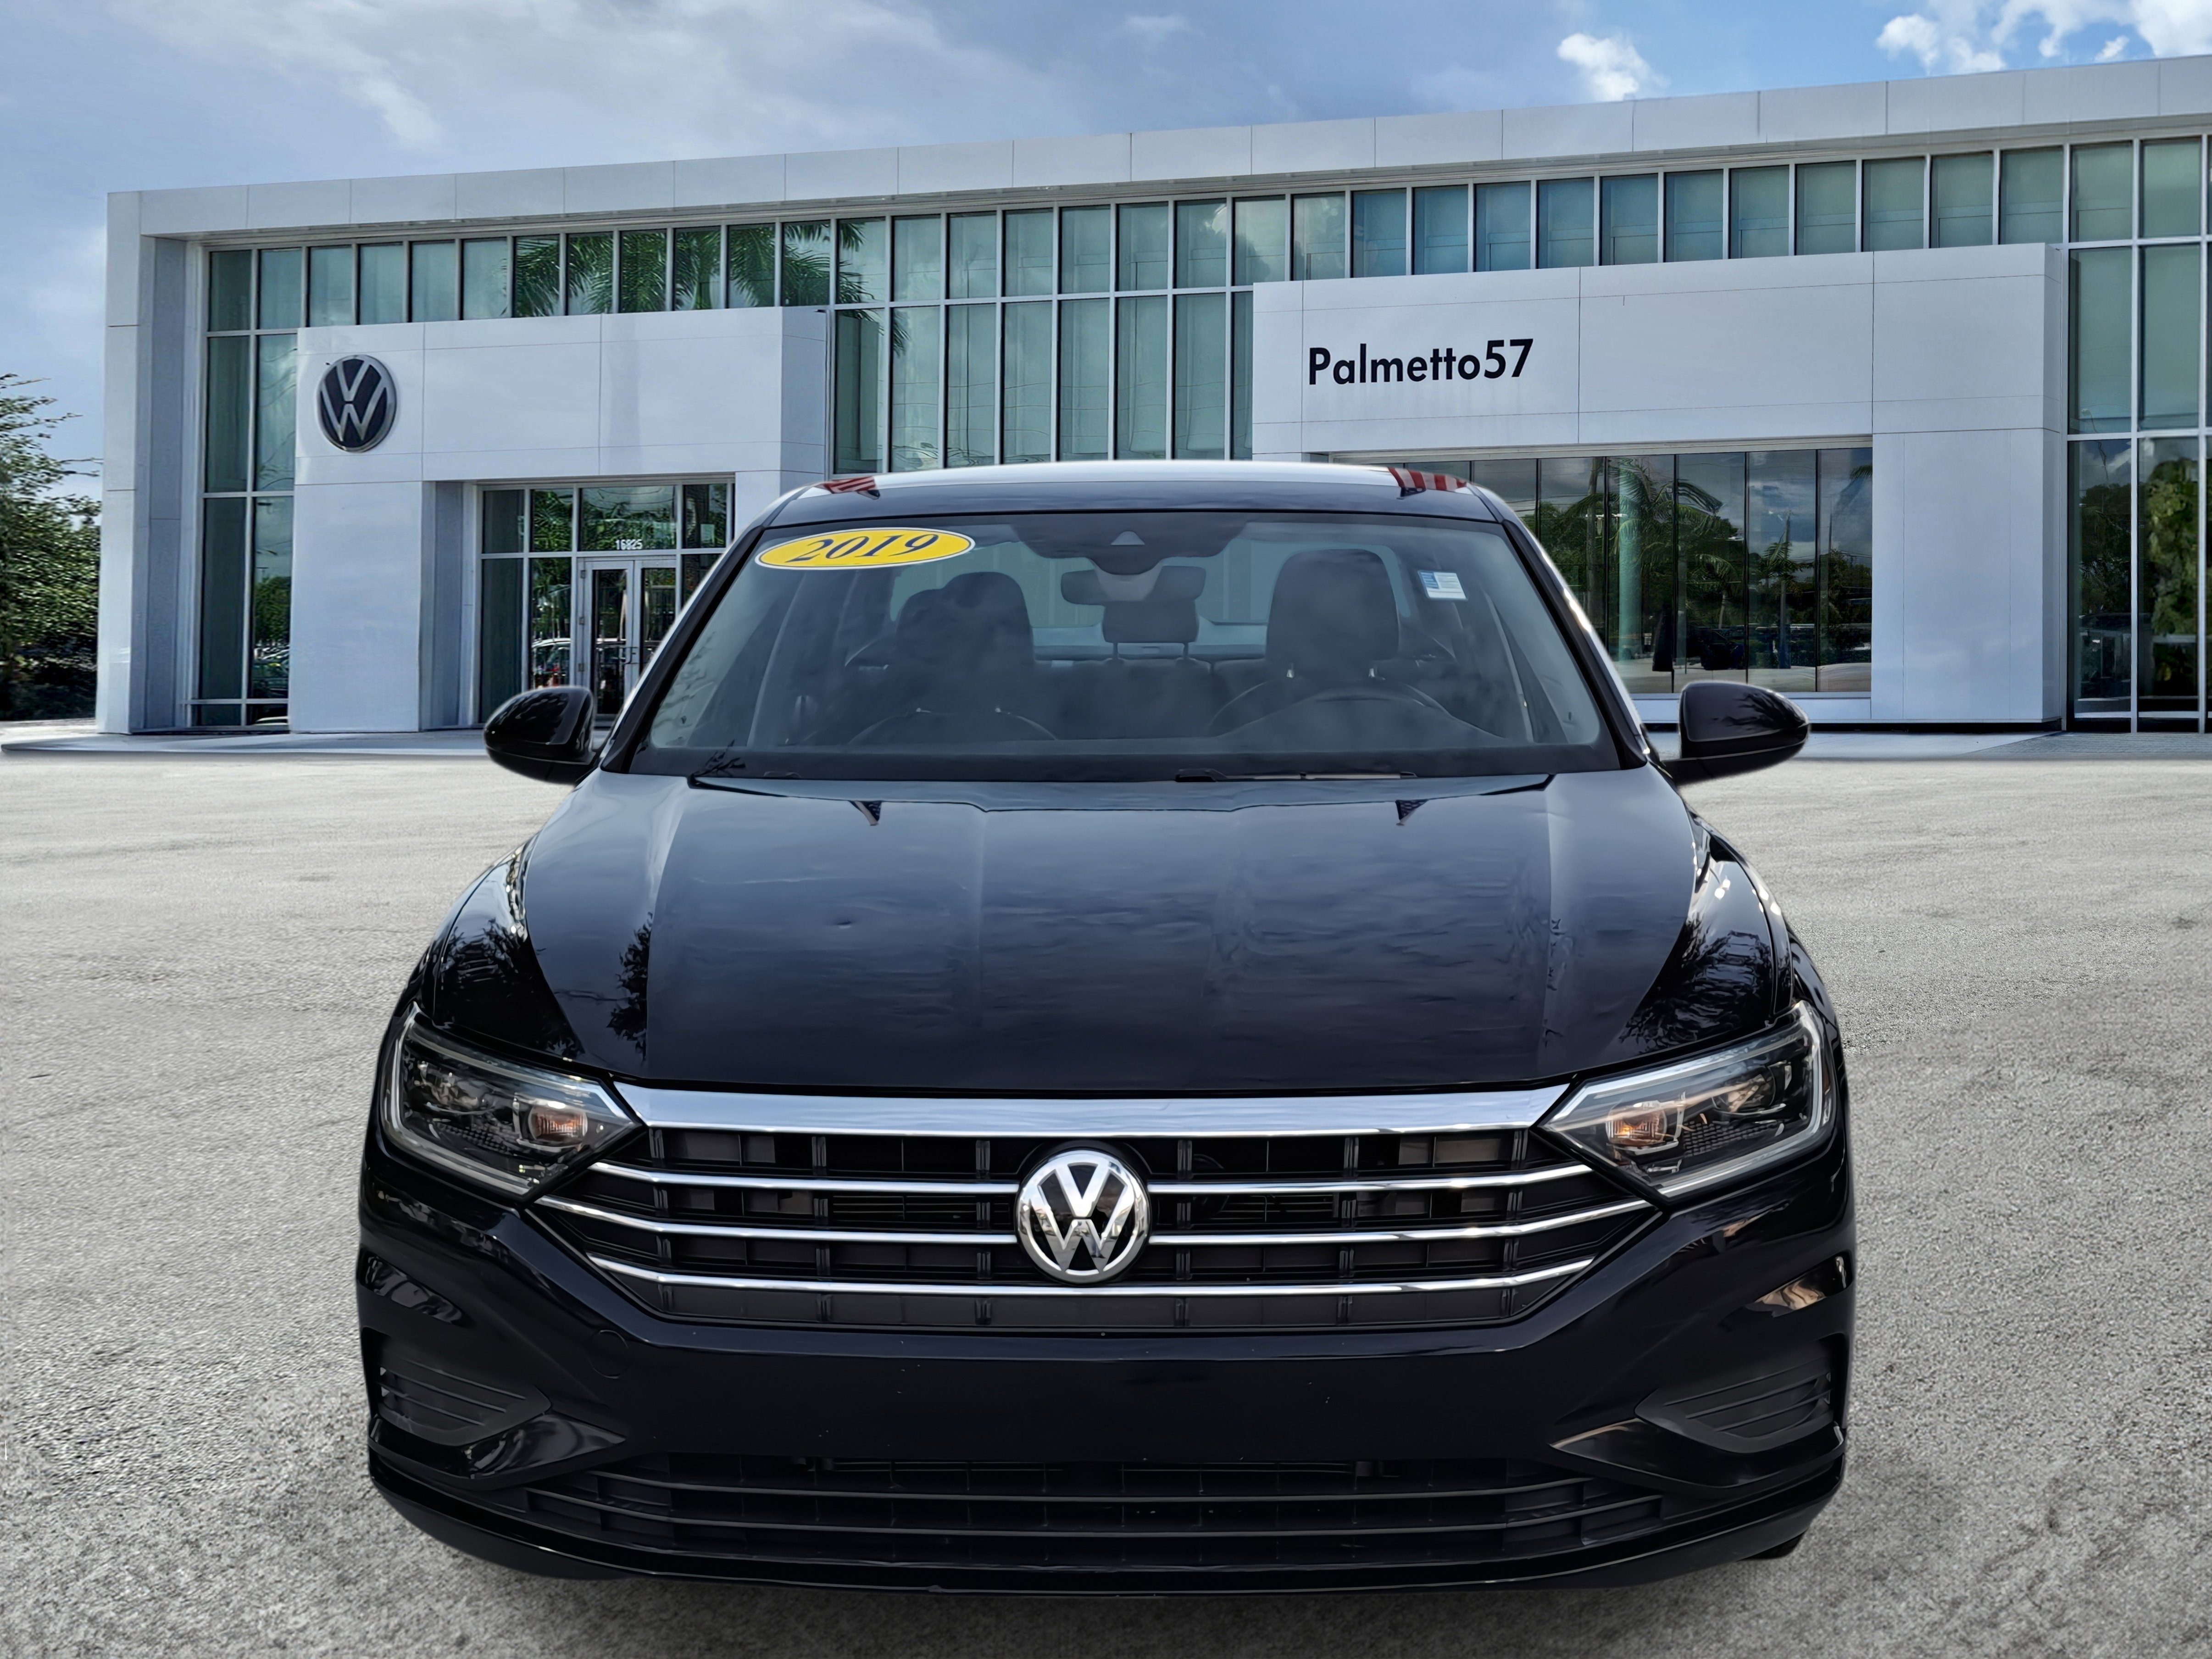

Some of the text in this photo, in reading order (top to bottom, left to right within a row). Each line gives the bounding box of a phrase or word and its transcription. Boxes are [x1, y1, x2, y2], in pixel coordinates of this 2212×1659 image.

[1309, 339, 1534, 385] Palmetto57
[318, 355, 394, 448] VW
[784, 534, 939, 563] 2019
[1021, 1153, 1145, 1279] VW
